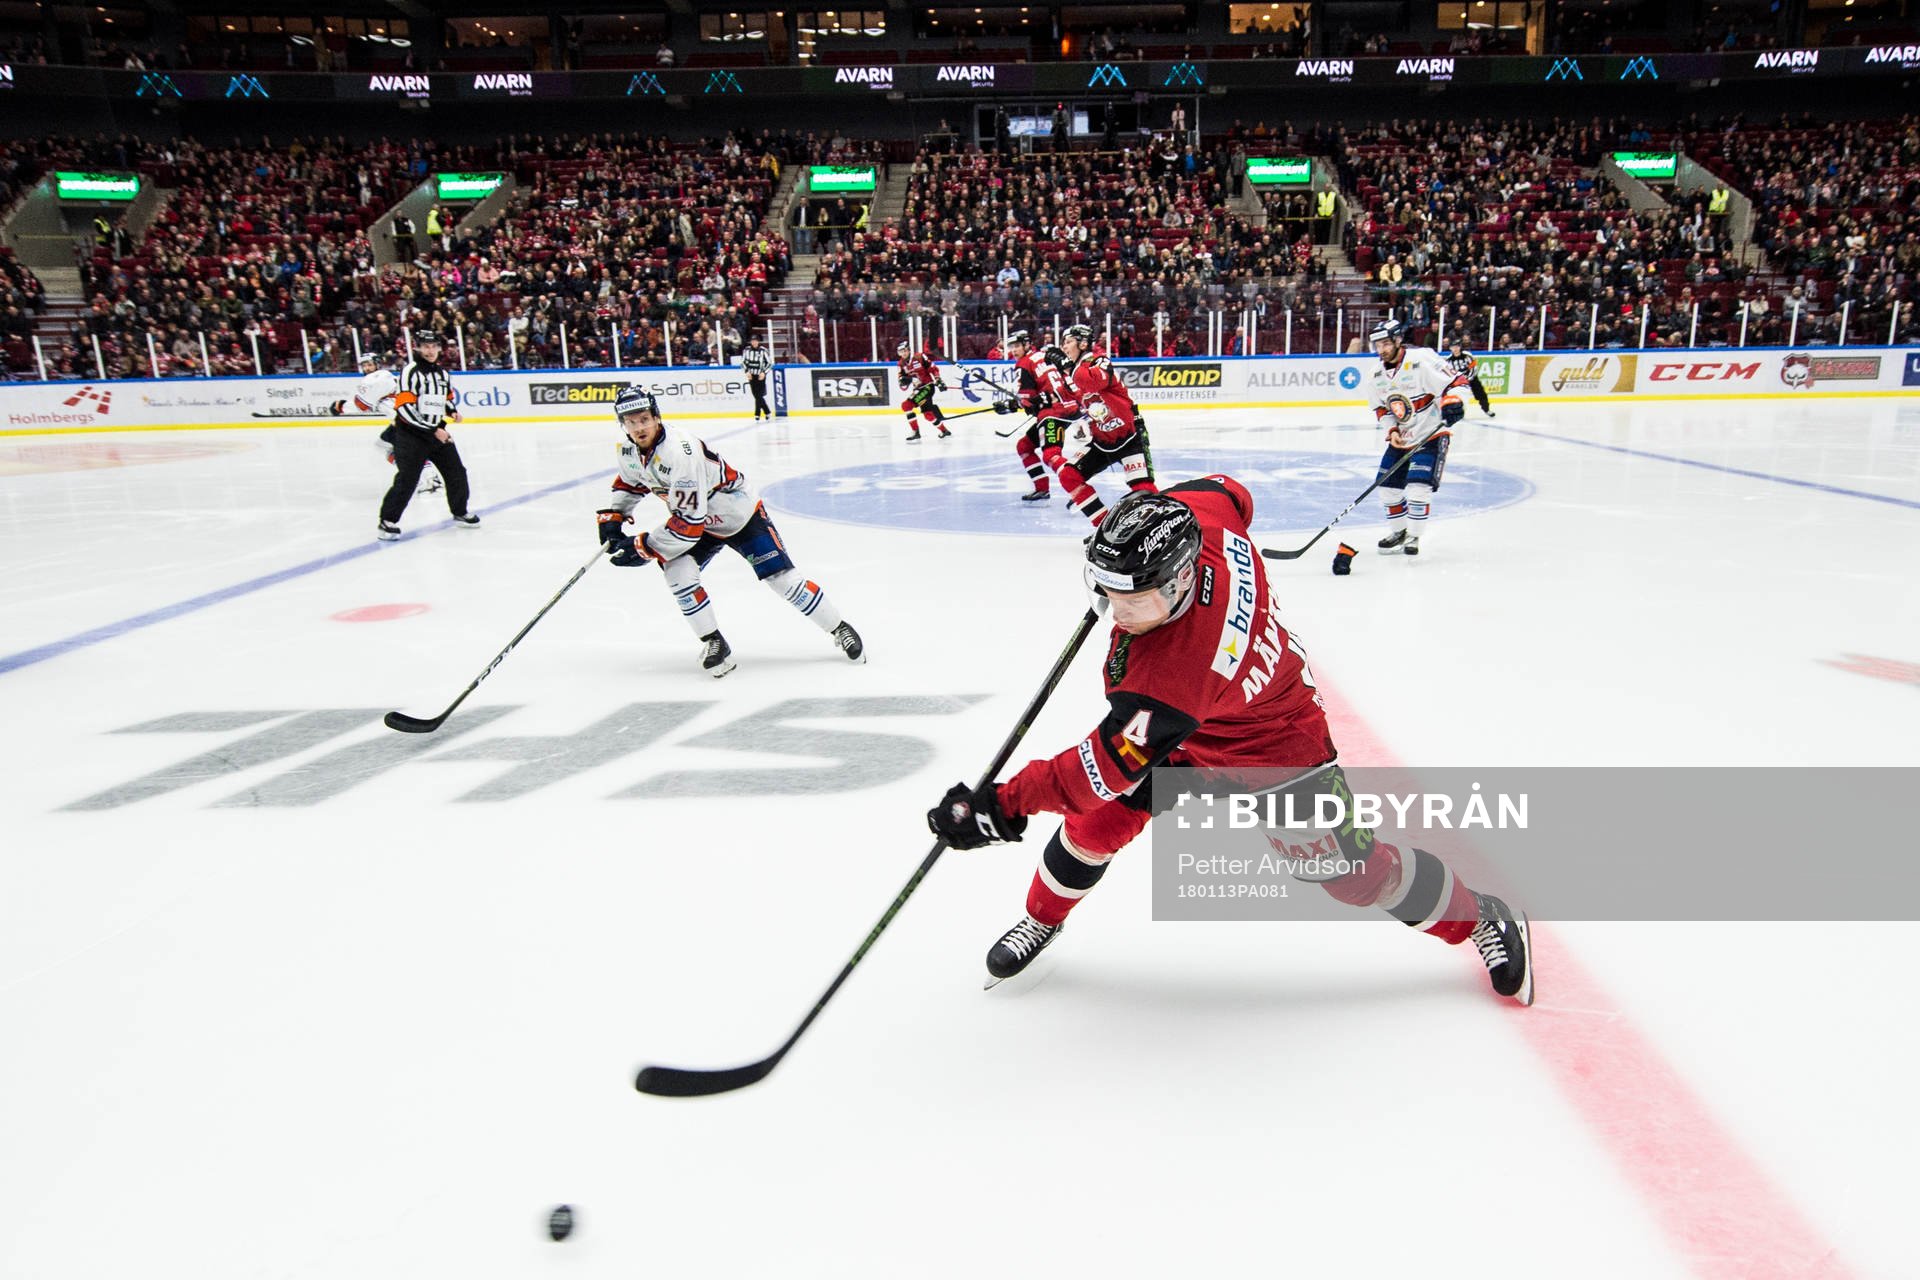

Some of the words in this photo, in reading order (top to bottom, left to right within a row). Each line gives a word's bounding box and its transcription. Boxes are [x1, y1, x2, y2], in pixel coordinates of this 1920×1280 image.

[1395, 59, 1454, 74] AVARN
[1754, 50, 1818, 68] AVARN
[835, 67, 892, 82] AVARN
[936, 66, 994, 80] AVARN
[1296, 60, 1353, 75] AVARN
[369, 75, 430, 91] AVARN
[474, 74, 532, 89] AVARN
[1113, 366, 1220, 387] Tedkomp
[1247, 371, 1336, 387] ALLIANCE
[1552, 357, 1608, 391] guld
[1648, 362, 1762, 381] CCM
[267, 387, 304, 399] Singel?
[532, 384, 620, 402] Tedadmi
[651, 379, 750, 397] sandber
[817, 378, 879, 397] RSA
[1131, 390, 1217, 400] STRIKOMPETENSER
[8, 412, 95, 425] Holmbergs
[676, 490, 699, 510] 24
[1096, 543, 1121, 556] CCM
[1201, 564, 1215, 605] CCM
[1122, 709, 1153, 746] 4
